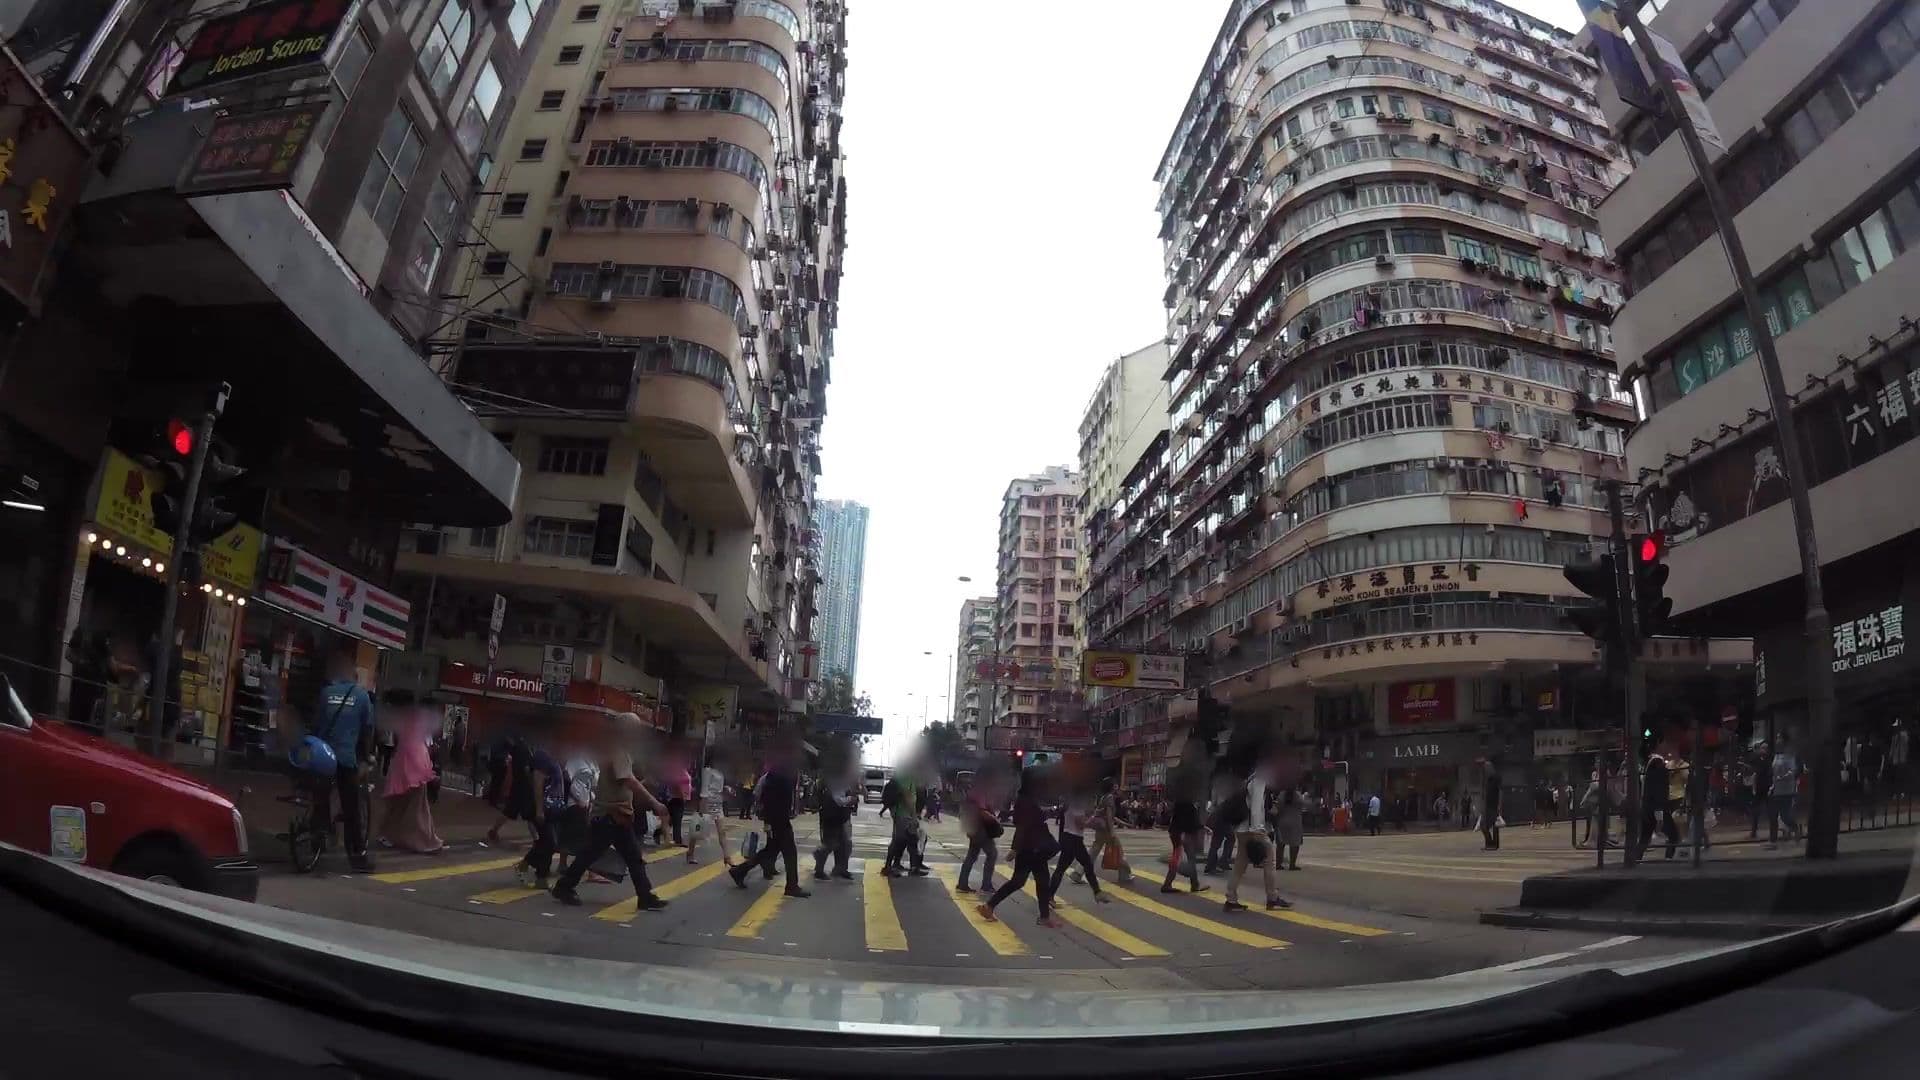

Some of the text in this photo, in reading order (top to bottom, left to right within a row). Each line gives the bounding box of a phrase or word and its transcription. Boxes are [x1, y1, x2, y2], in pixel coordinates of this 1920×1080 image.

[208, 35, 326, 75] Jordan Sauna
[1356, 590, 1381, 600] KONG
[1384, 584, 1429, 596] SEAMEN'S
[1432, 582, 1461, 592] UNION
[1832, 604, 1905, 658] 福珠寶
[1832, 643, 1905, 673] OOK JEWELLERY
[1393, 743, 1441, 758] LAMB
